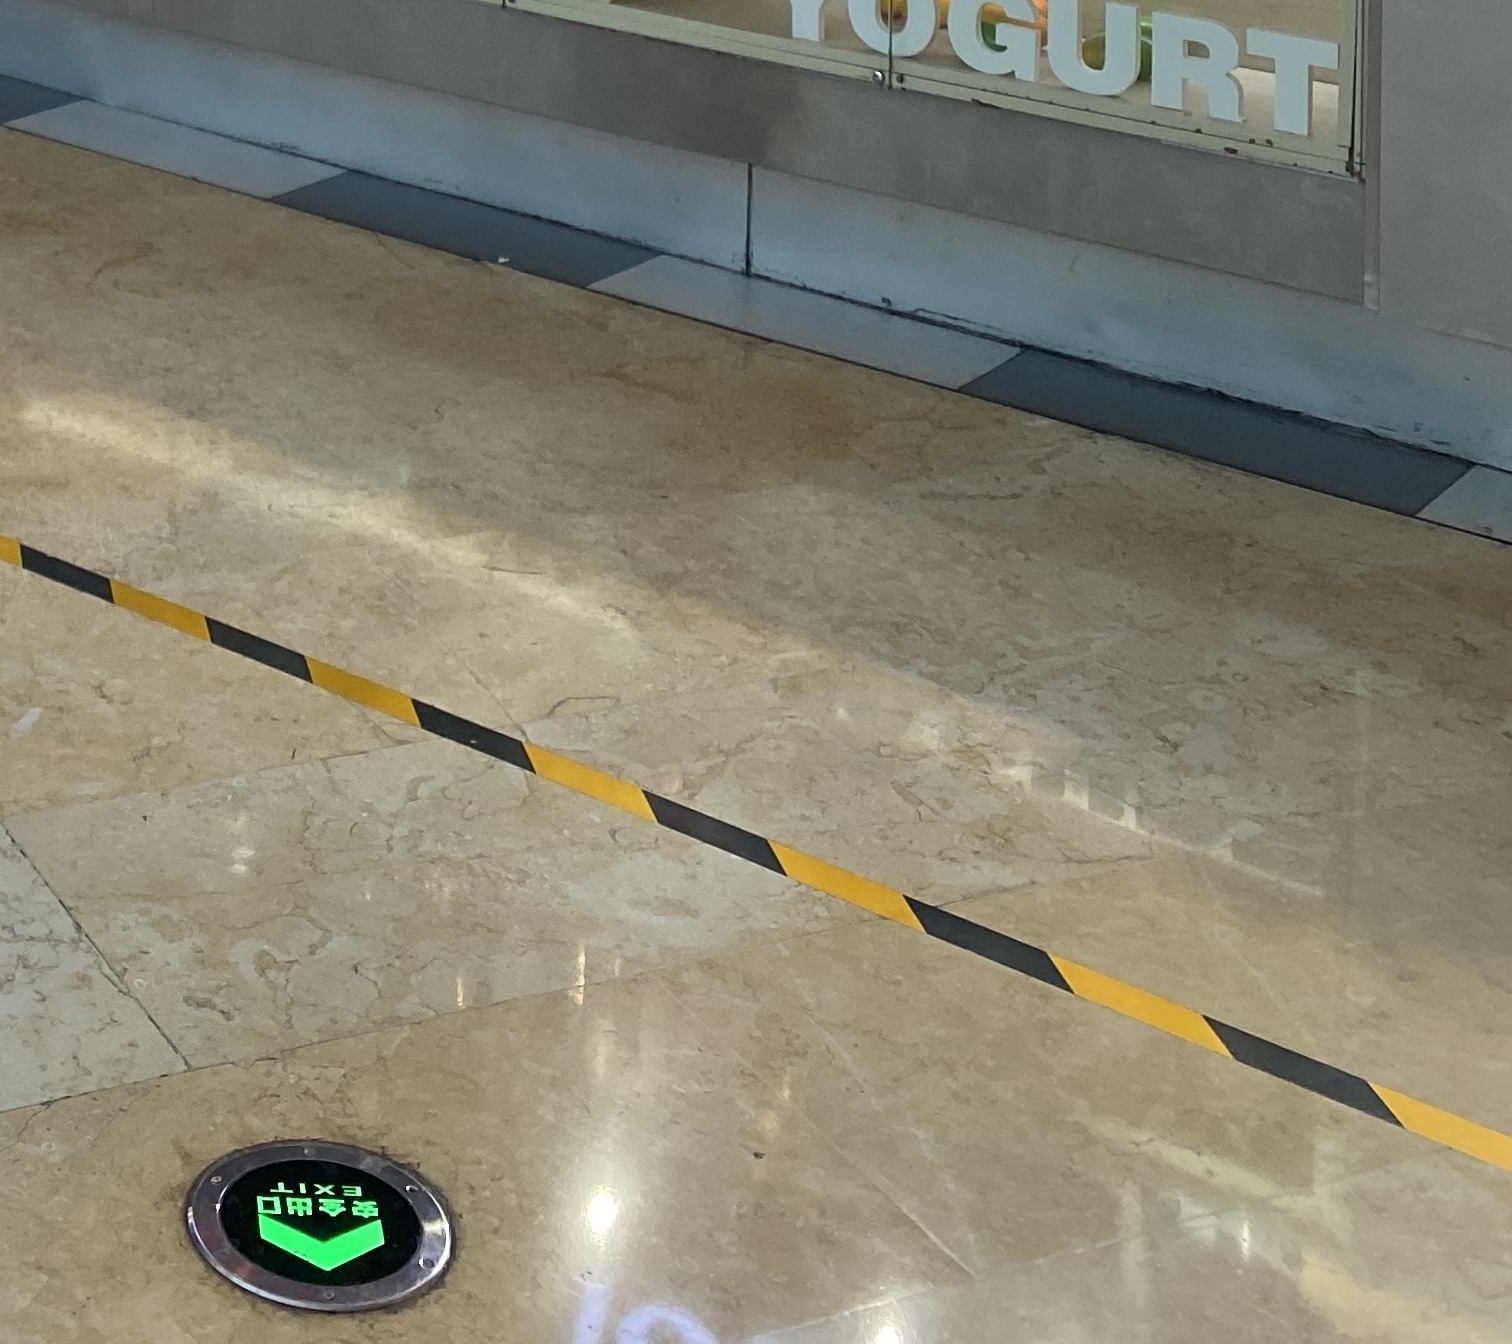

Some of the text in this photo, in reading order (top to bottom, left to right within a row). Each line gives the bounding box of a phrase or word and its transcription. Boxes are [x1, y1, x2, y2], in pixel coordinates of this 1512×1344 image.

[270, 1182, 363, 1197] EXIT
[256, 1196, 379, 1218] 安全出口
